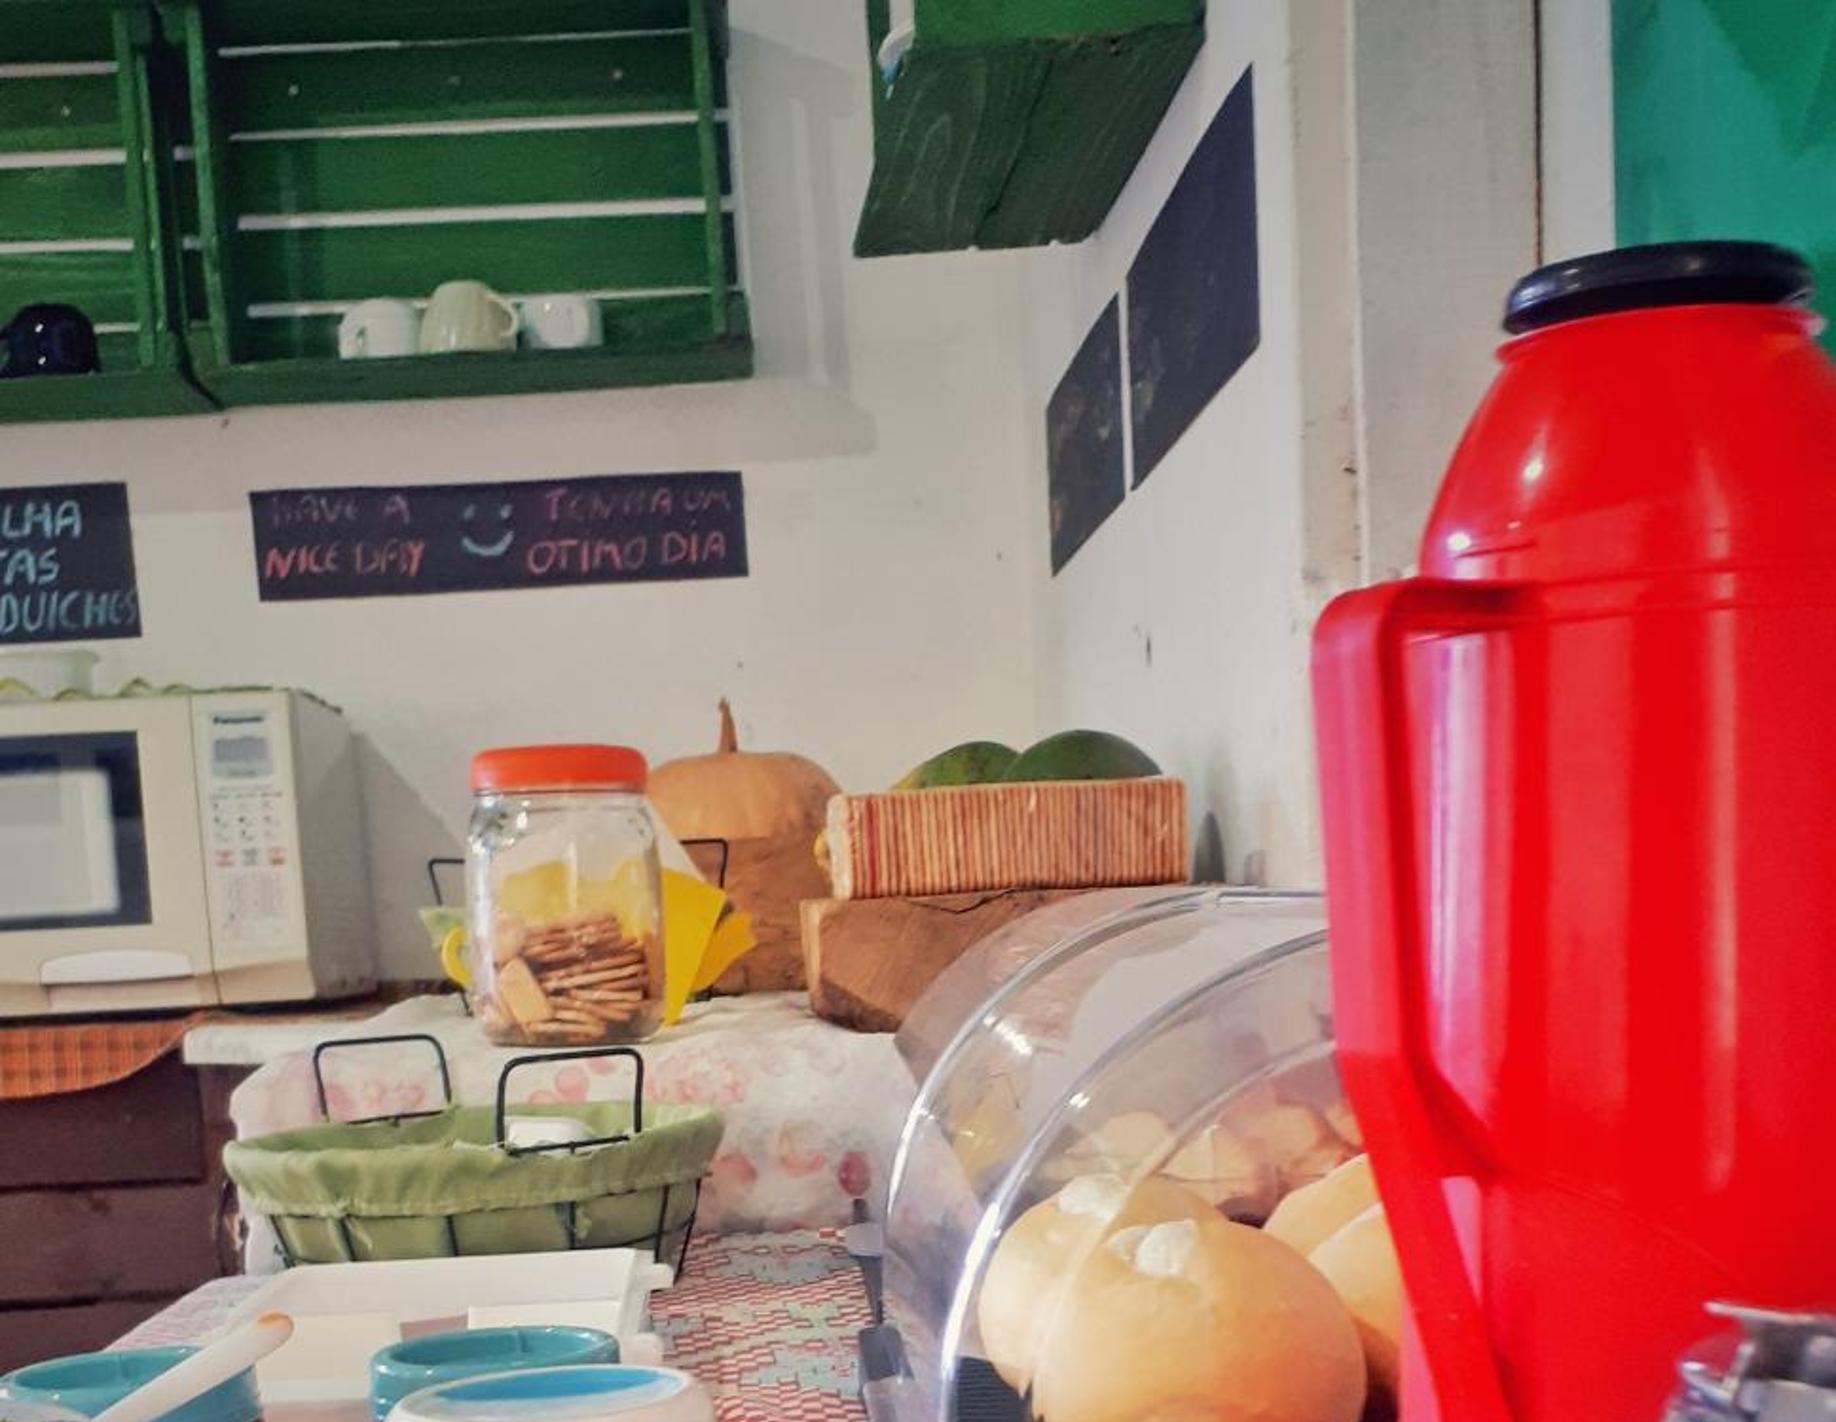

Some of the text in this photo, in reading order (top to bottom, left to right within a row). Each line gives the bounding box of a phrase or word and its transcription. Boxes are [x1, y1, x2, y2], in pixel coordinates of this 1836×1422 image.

[382, 493, 411, 526] A
[264, 538, 426, 580] NICE DAY
